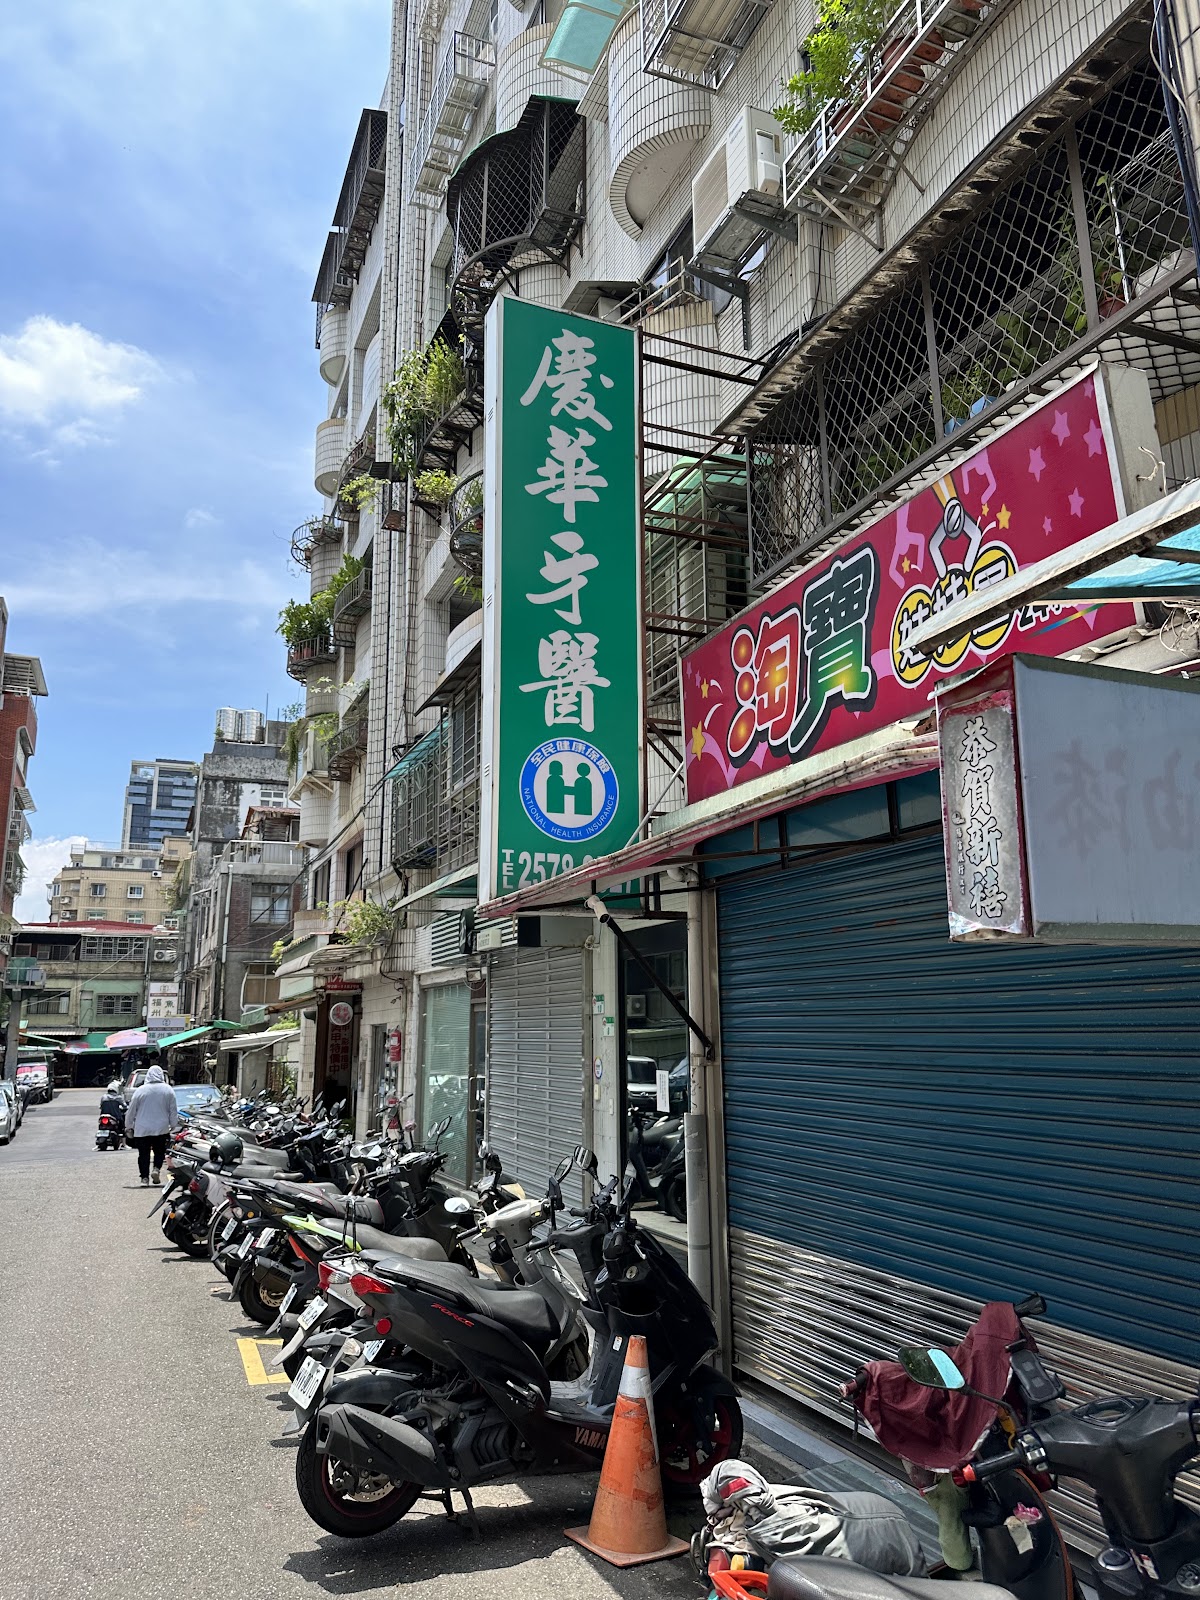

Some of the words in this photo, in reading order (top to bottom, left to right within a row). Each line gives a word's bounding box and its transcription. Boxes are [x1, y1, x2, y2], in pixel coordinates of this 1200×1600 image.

[520, 328, 614, 732] 慶華牙醫
[728, 547, 874, 757] 淘寶
[523, 787, 546, 828] NATIONAL
[551, 826, 582, 838] HEALTH
[586, 794, 614, 835] INSURANCE
[530, 740, 611, 774] 全民健康保險
[959, 715, 1008, 918] 恭賀新禧
[501, 849, 514, 889] TEL
